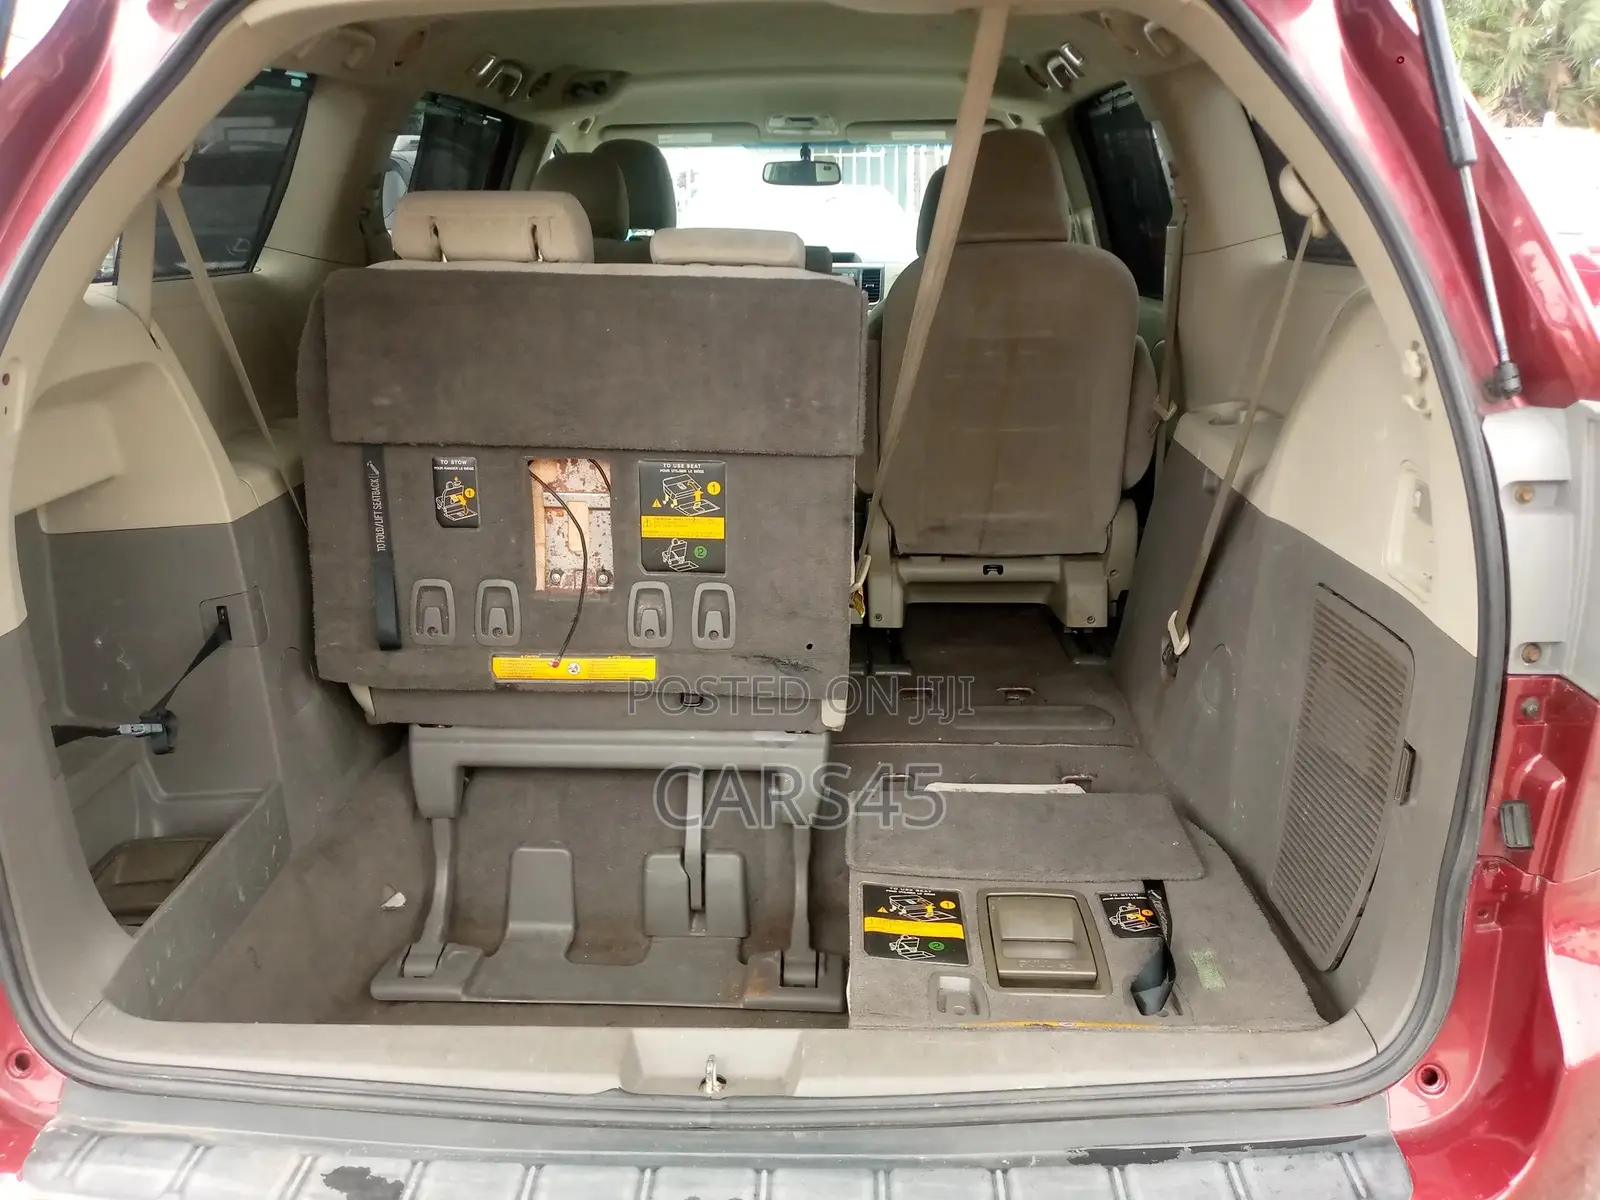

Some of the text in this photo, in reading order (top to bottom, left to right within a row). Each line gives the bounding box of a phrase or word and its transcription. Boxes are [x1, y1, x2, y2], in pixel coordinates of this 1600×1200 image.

[370, 478, 386, 552] TO FOLD/LIFT SEATBACK
